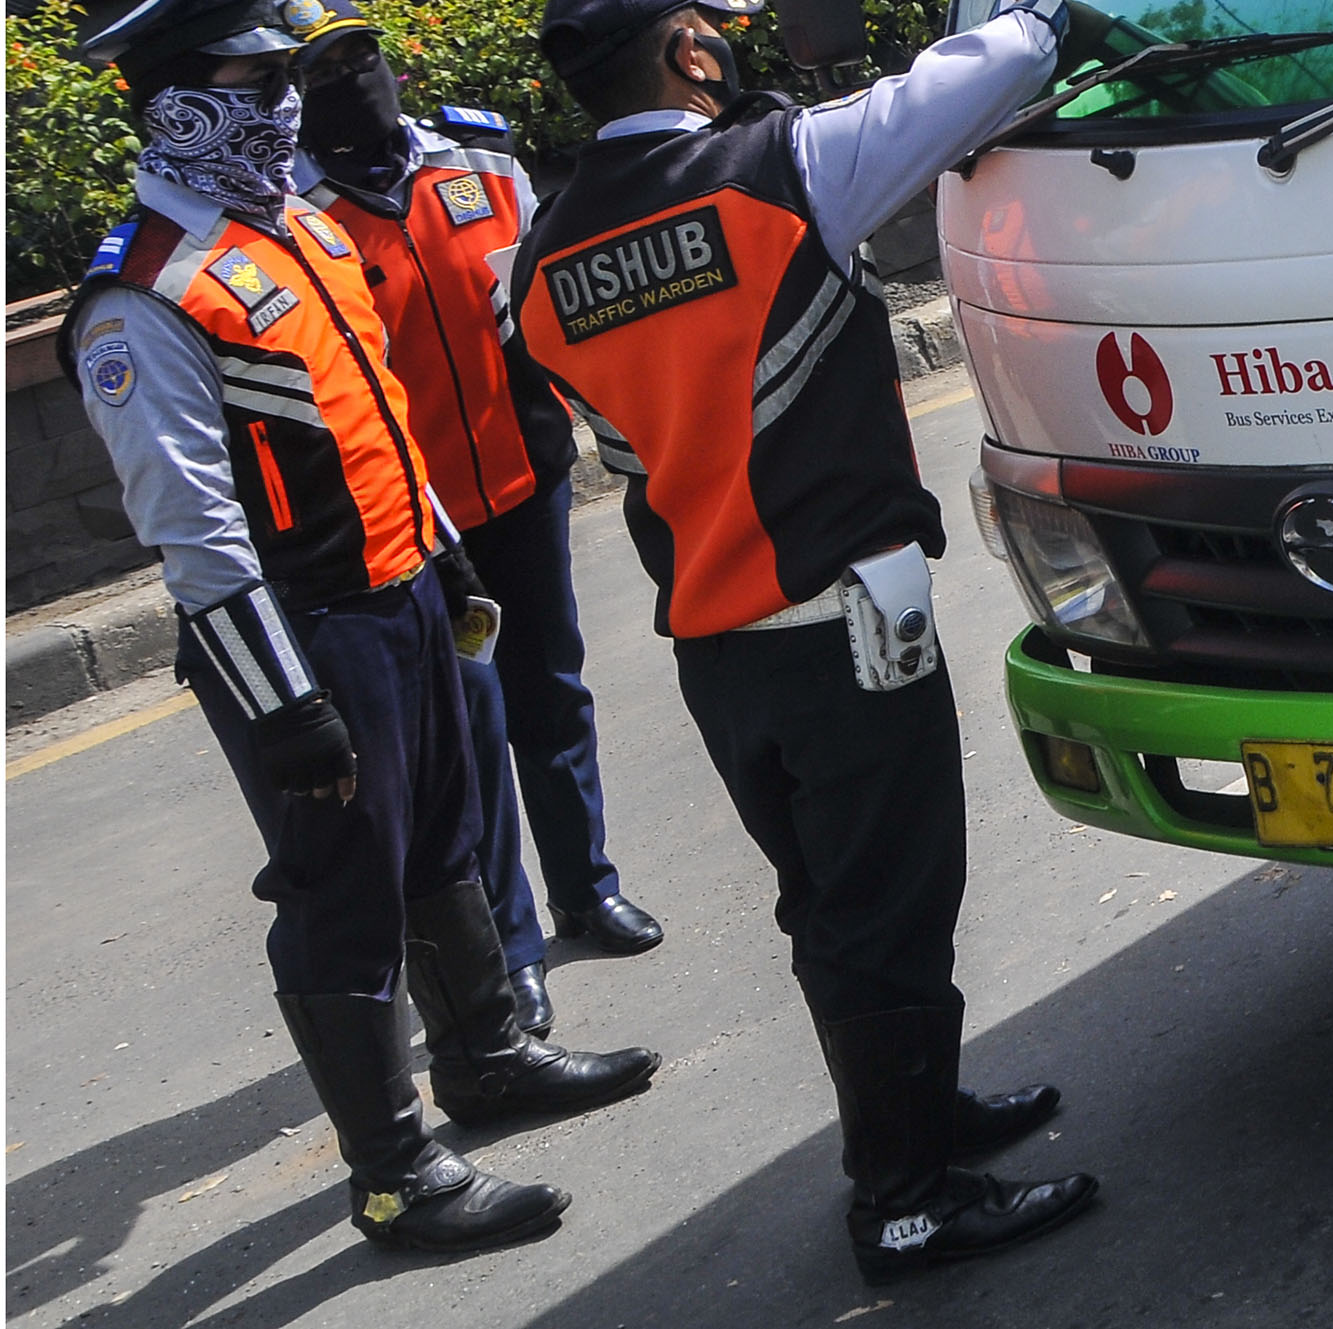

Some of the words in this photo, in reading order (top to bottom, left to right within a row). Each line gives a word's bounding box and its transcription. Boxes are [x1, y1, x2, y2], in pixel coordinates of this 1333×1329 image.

[552, 221, 713, 317] DISHUB
[255, 295, 289, 329] IRFAN
[568, 299, 636, 335] TRAFFIC
[640, 268, 724, 308] WARDEN
[1225, 411, 1252, 428] Bus
[1255, 409, 1313, 426] Services
[1108, 442, 1147, 460] HIBA
[1147, 446, 1201, 464] GROUP
[1247, 752, 1278, 813] B
[889, 1217, 928, 1242] LLAJ
